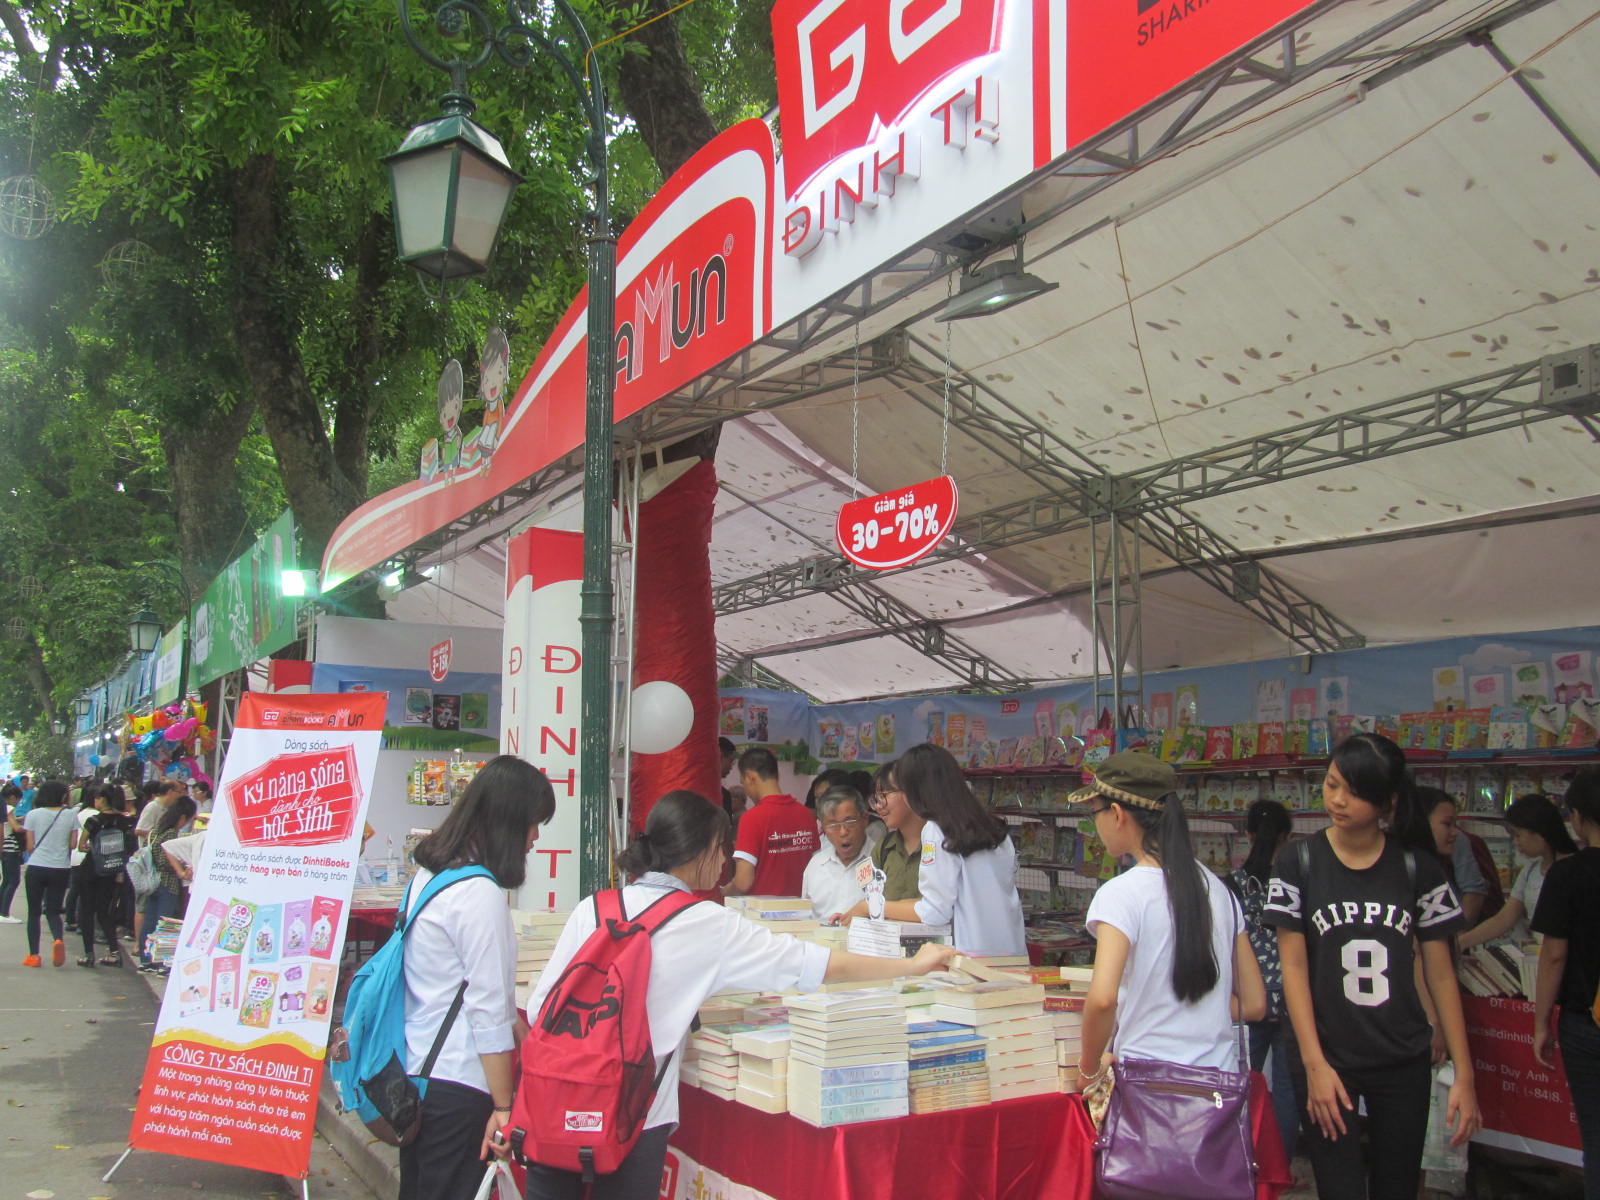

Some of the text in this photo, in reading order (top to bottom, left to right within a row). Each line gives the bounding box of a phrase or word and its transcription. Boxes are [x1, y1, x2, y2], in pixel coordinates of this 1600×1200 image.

[874, 491, 915, 514] Giảm giá
[851, 503, 939, 553] 30-70%
[1311, 901, 1413, 937] HIPPIE
[1341, 939, 1390, 1007] 8
[164, 1043, 205, 1065] CÔNG
[209, 1052, 226, 1068] TY
[227, 1053, 263, 1074] SÁCH
[265, 1061, 299, 1081] ĐINH
[158, 1067, 177, 1081] Một
[178, 1072, 202, 1086] trong
[204, 1074, 233, 1091] những
[234, 1080, 256, 1095] công
[258, 1084, 268, 1098] ty
[285, 1088, 310, 1103] thuộc
[163, 1105, 187, 1121] hàng
[189, 1110, 210, 1122] trăm
[211, 1114, 235, 1127] ngàn
[258, 1122, 279, 1135] sách
[280, 1125, 303, 1141] được
[187, 1090, 210, 1103] phát
[211, 1094, 234, 1107] hành
[236, 1098, 257, 1112] sách
[258, 1103, 275, 1115] cho
[290, 1110, 306, 1121] em
[143, 1121, 166, 1134] phát
[167, 1124, 190, 1138] hành
